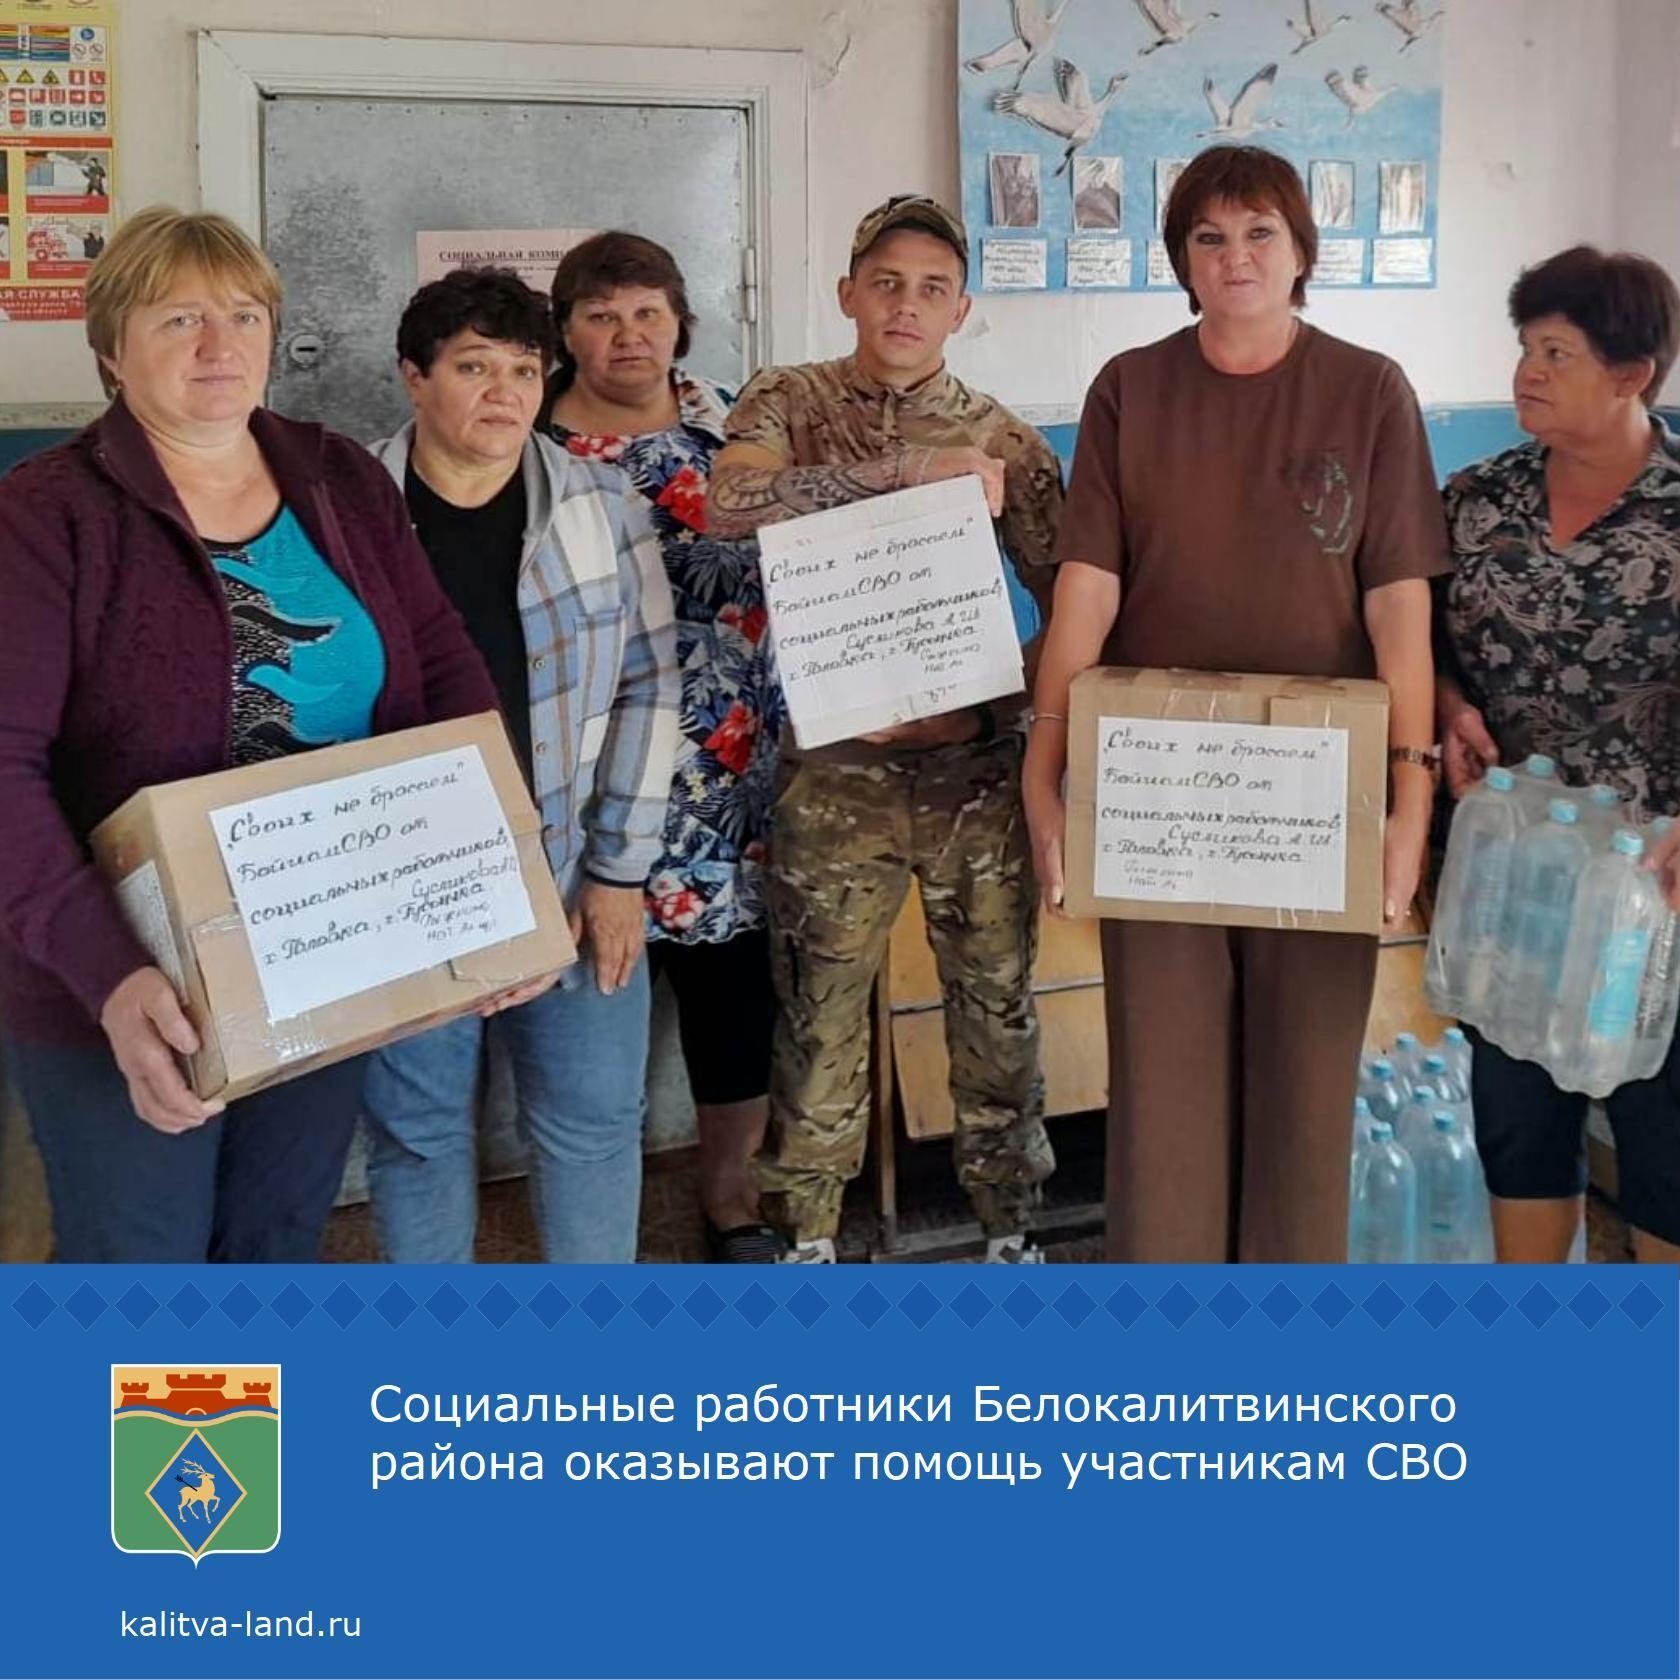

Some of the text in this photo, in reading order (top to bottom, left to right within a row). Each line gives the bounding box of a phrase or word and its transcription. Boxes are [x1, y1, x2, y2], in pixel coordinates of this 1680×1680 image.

[855, 549, 879, 562] не
[858, 571, 901, 596] СВО
[909, 568, 931, 582] от
[780, 611, 894, 649] социальных
[1197, 742, 1223, 754] не
[1193, 771, 1240, 788] СВО
[1246, 779, 1272, 791] от
[334, 798, 360, 816] не
[1101, 805, 1223, 823] социальных
[341, 823, 391, 851] СВО
[400, 817, 427, 837] от
[251, 868, 388, 925] социальных
